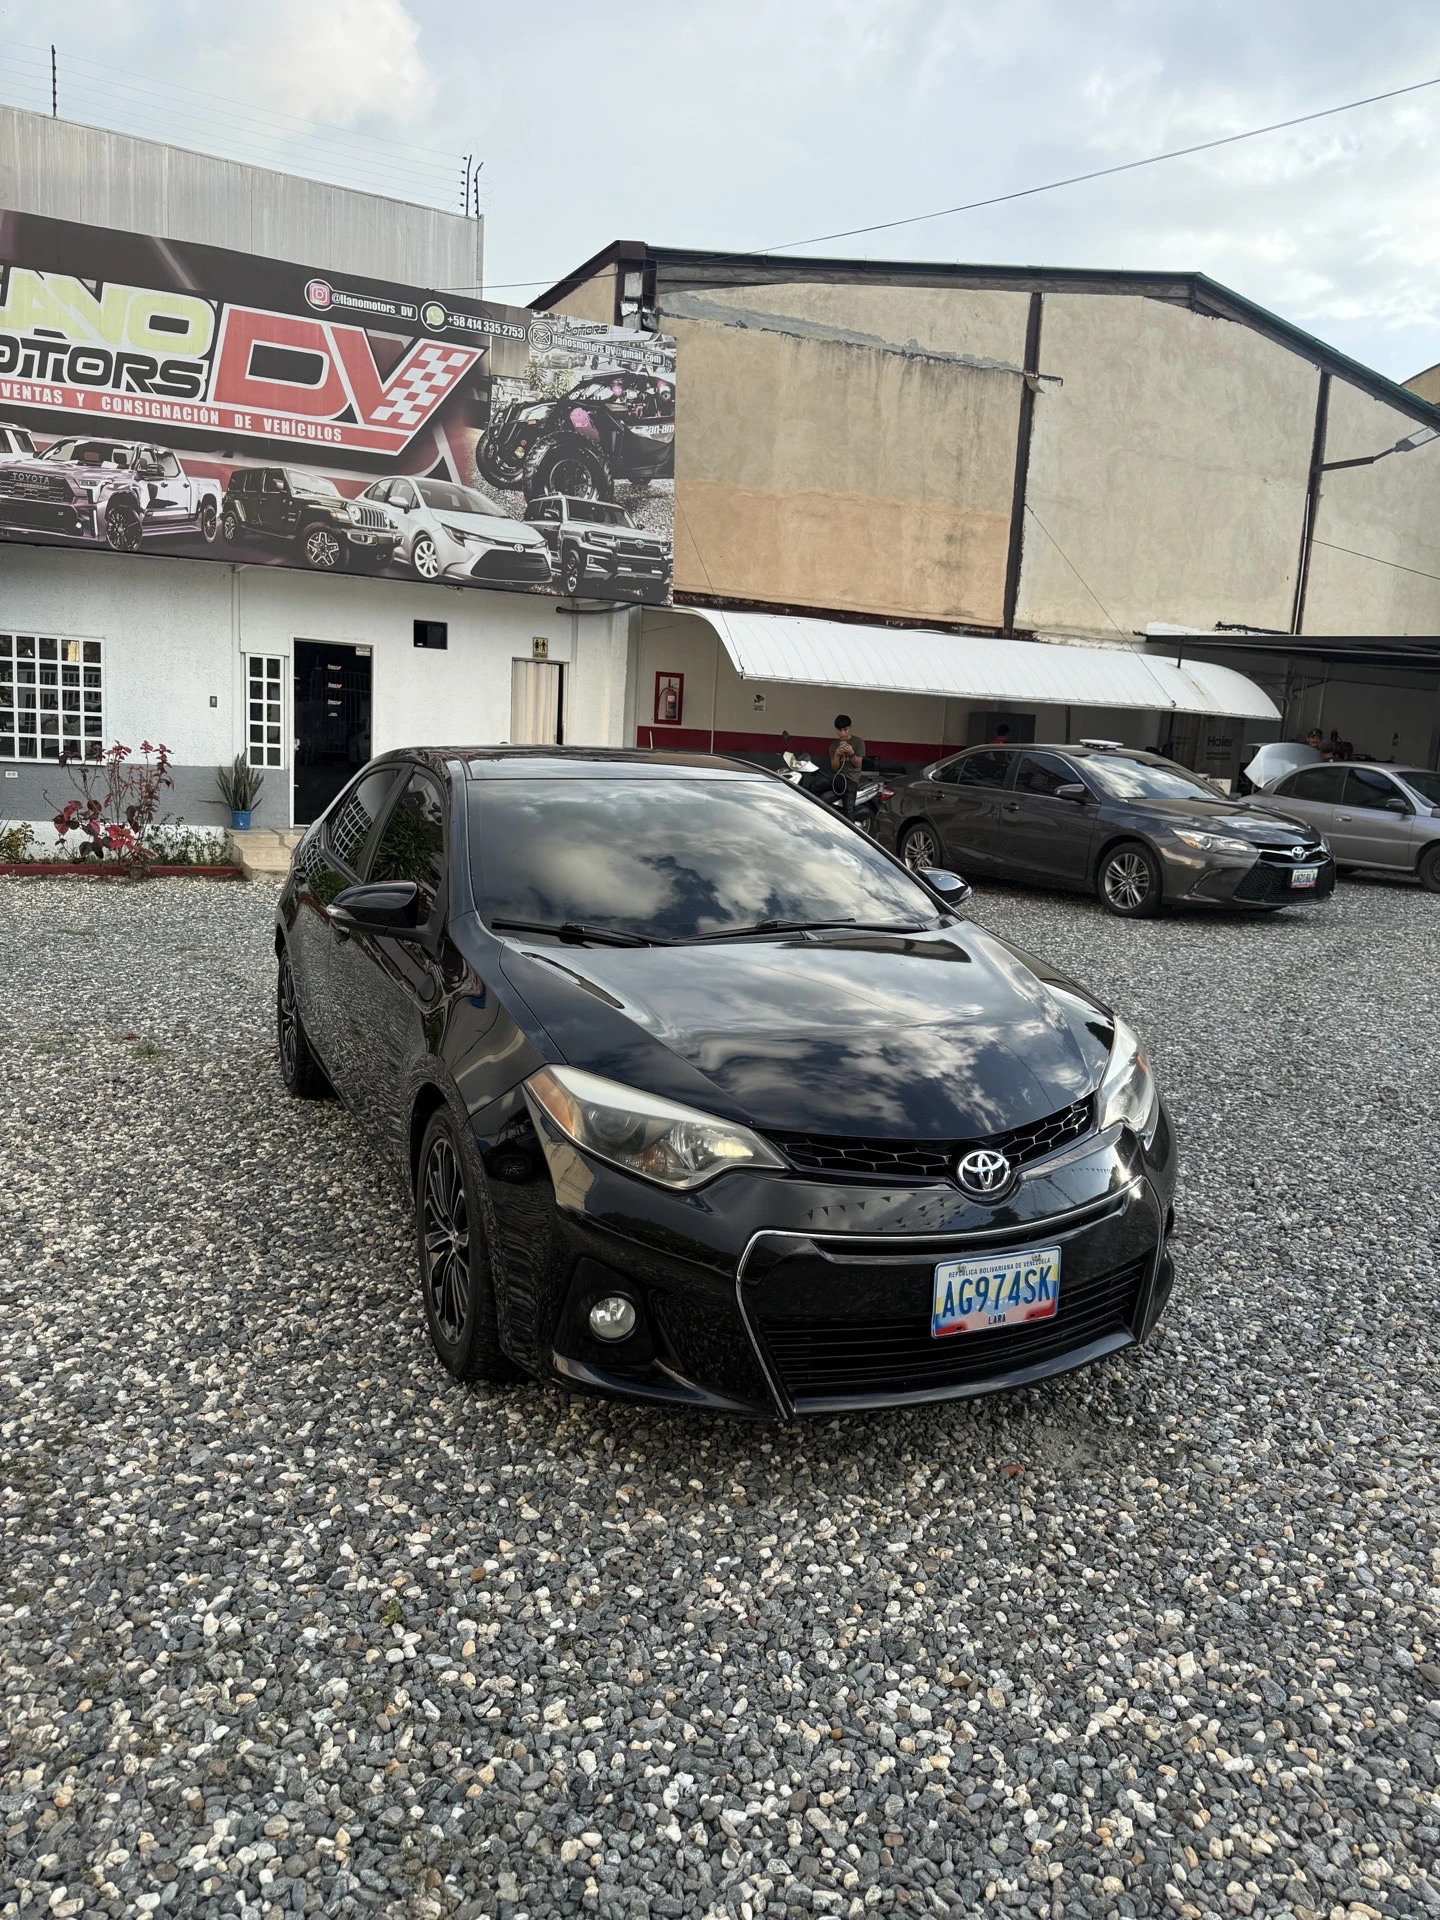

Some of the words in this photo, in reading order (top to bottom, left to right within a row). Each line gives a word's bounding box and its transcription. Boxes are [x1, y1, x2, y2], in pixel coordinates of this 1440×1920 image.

[447, 314, 466, 328] +58
[466, 318, 482, 331] 414
[483, 321, 501, 334] 335
[502, 324, 524, 339] 2753
[210, 304, 484, 430] DV
[1, 381, 63, 404] VENTAS
[76, 392, 86, 407] Y
[101, 395, 220, 425] CONSIGNACIÓN
[234, 413, 252, 430] DE
[263, 416, 342, 442] VEHÍCULOS
[12, 472, 50, 484] TOYOTA
[1207, 735, 1233, 747] Haier
[979, 1263, 1014, 1275] BOLIVARIANA
[1015, 1261, 1022, 1269] DE
[1023, 1256, 1051, 1268] VENEZUELA
[942, 1265, 1053, 1318] AG974SK
[988, 1313, 1006, 1325] LARA
